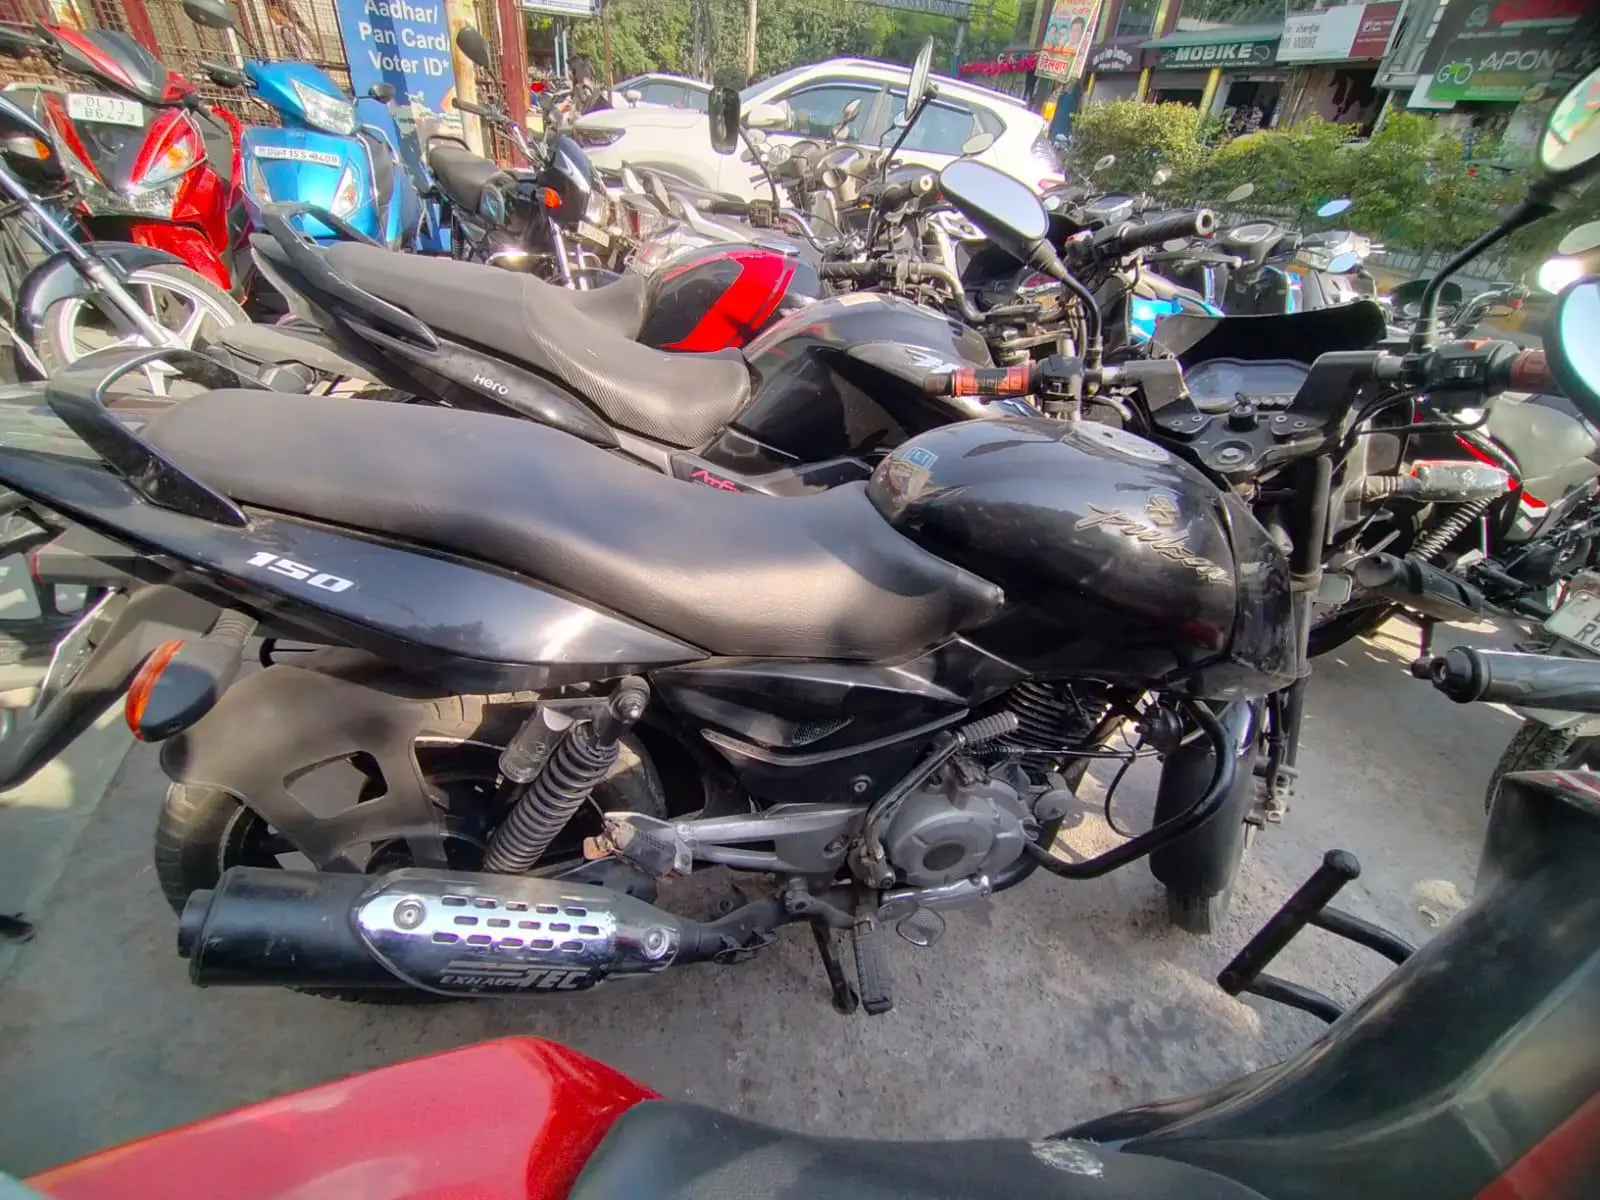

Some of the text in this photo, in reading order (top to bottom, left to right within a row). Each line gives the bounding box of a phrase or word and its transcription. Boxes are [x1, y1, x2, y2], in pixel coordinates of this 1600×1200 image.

[364, 0, 438, 24] Aadhar/
[358, 21, 397, 45] Pan
[368, 49, 419, 74] Voter
[1174, 43, 1254, 62] MOBIKE
[473, 373, 509, 395] Hero
[246, 551, 355, 593] 150
